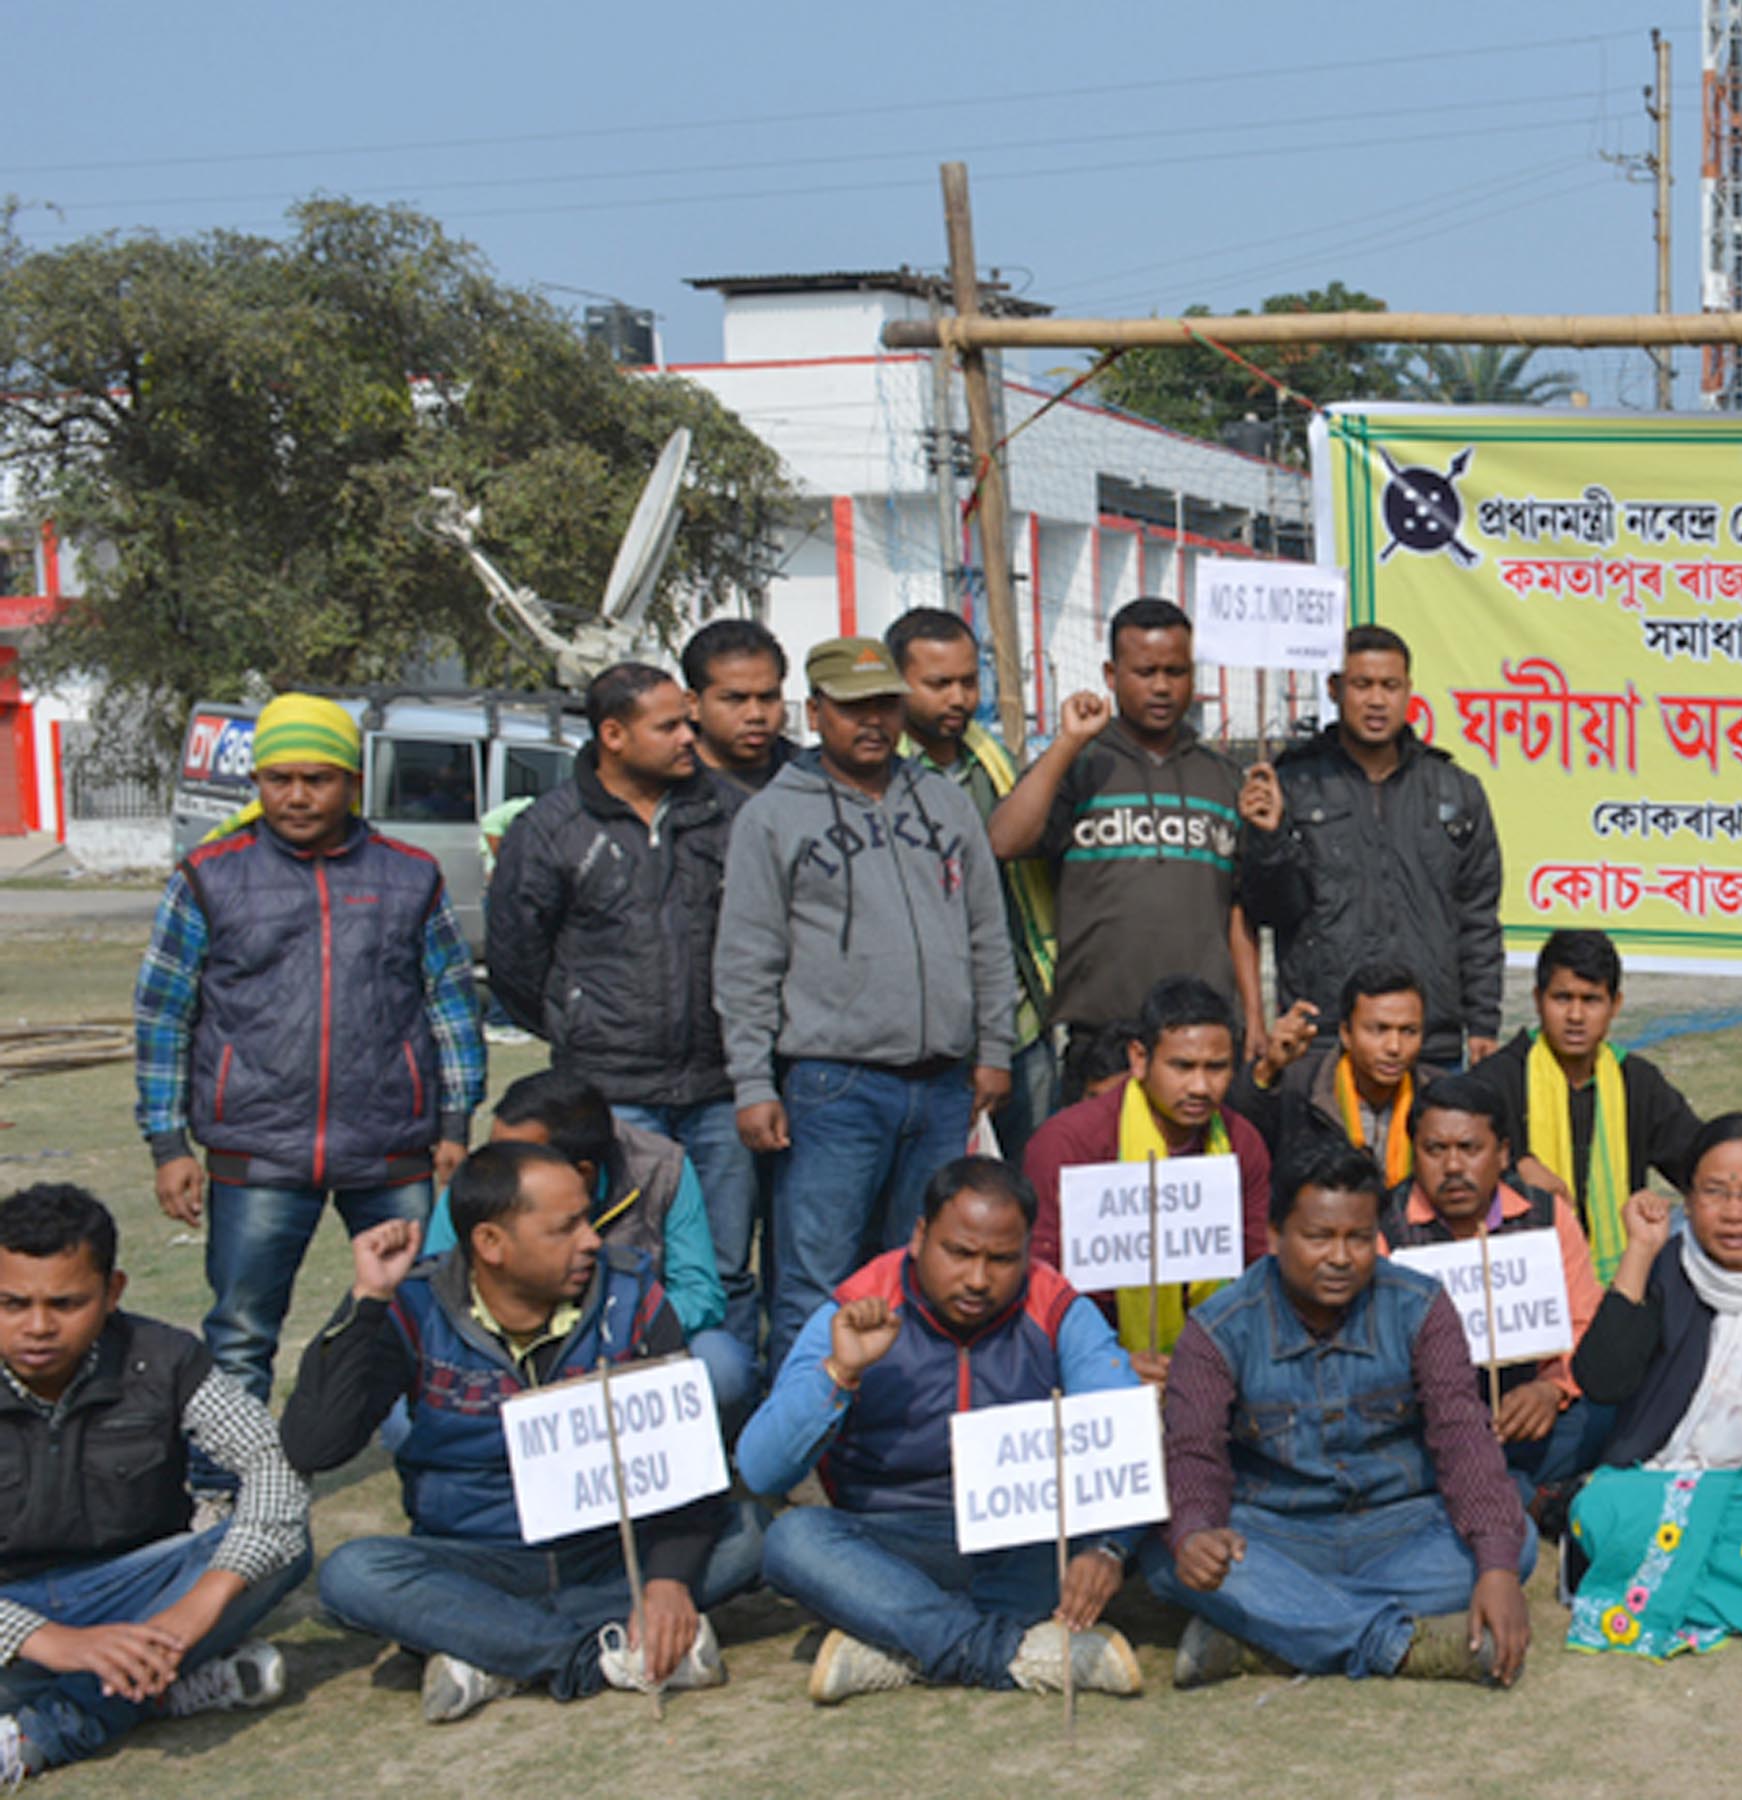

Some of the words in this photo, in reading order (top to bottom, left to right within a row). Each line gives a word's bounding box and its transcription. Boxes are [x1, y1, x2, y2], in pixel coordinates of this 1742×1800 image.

[1074, 807, 1208, 847] adidas
[1072, 1232, 1151, 1267] LONG
[1165, 1226, 1232, 1260] LIVE
[1434, 1258, 1527, 1295] KRSU
[1496, 1298, 1561, 1333] LIVE
[517, 1412, 561, 1459] MY
[569, 1389, 666, 1447] BLOOD
[671, 1381, 702, 1422] IS
[967, 1478, 1059, 1523] LONG
[1074, 1461, 1151, 1506] LIVE
